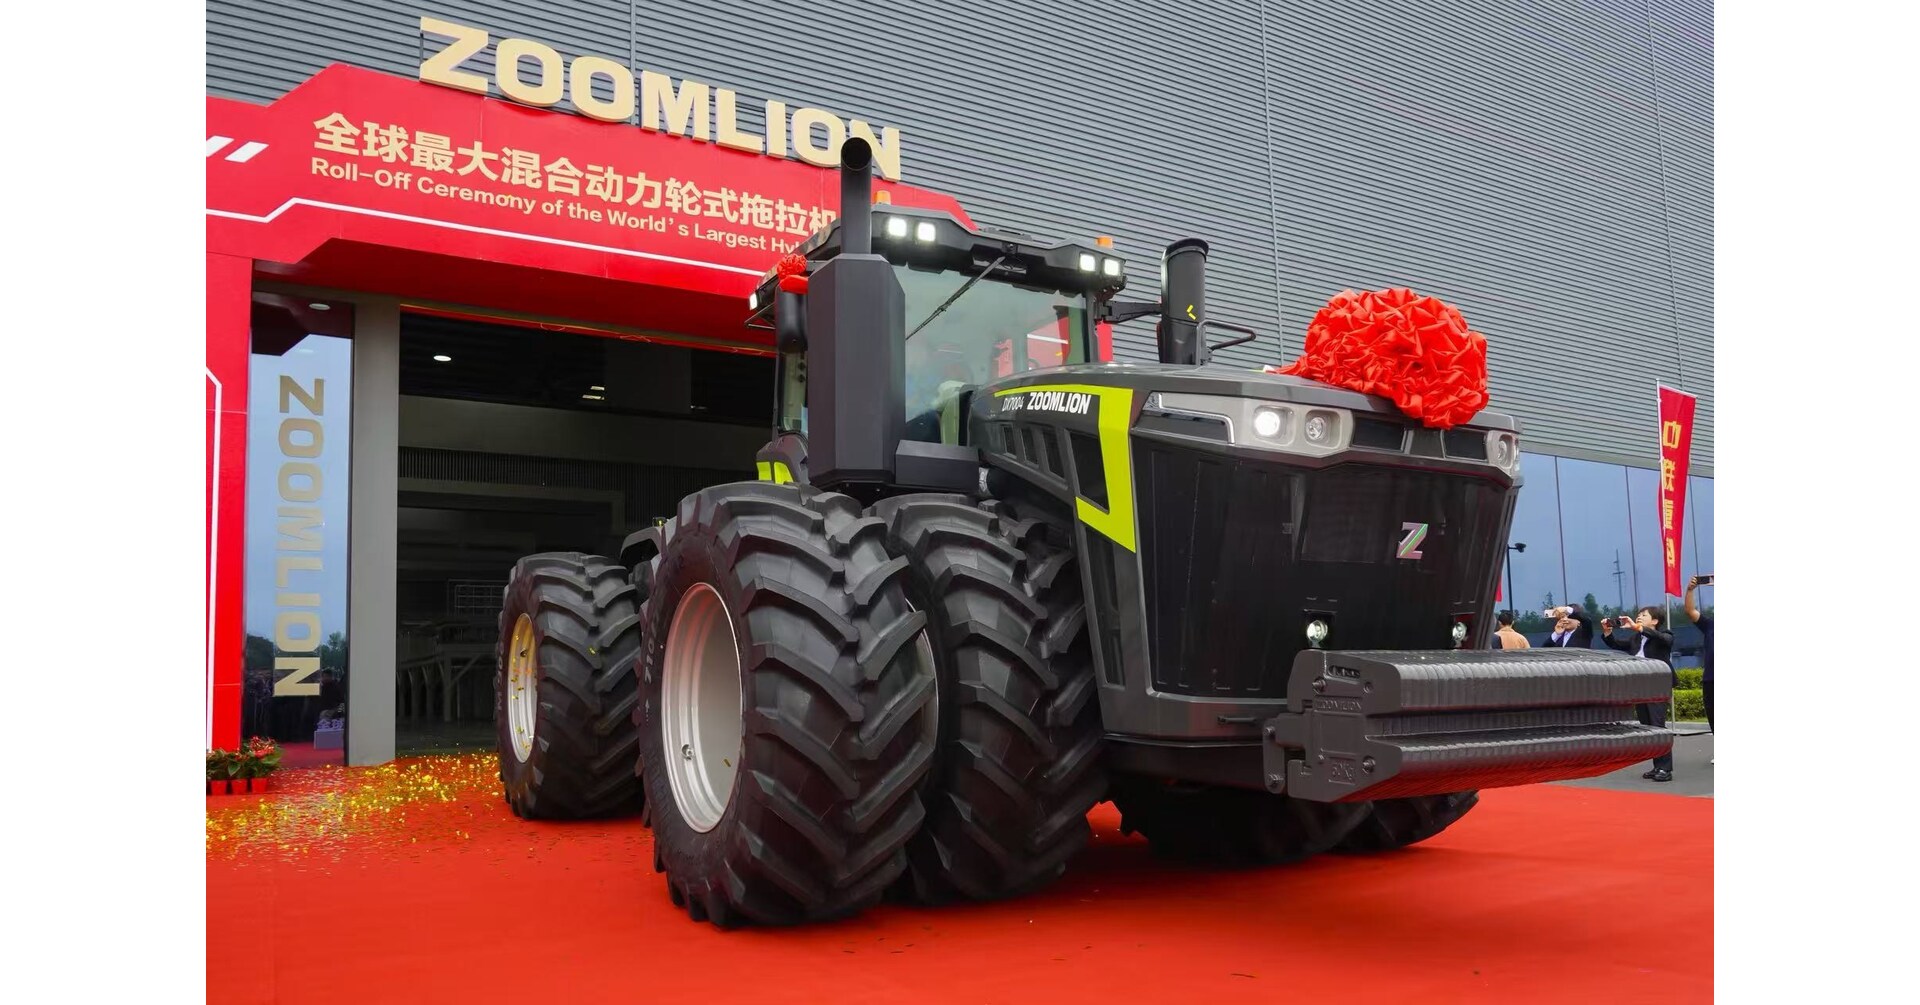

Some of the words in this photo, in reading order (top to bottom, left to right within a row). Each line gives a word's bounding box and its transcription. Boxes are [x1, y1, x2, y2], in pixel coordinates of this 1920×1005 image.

[420, 17, 900, 182] ZOOMLION
[417, 176, 536, 214] Ceremony
[541, 199, 563, 216] of
[567, 202, 603, 223] the
[694, 226, 767, 250] Largest
[771, 237, 800, 254] Hy
[1027, 391, 1092, 415] ZOOMLION
[272, 374, 325, 697] ZOOMLION
